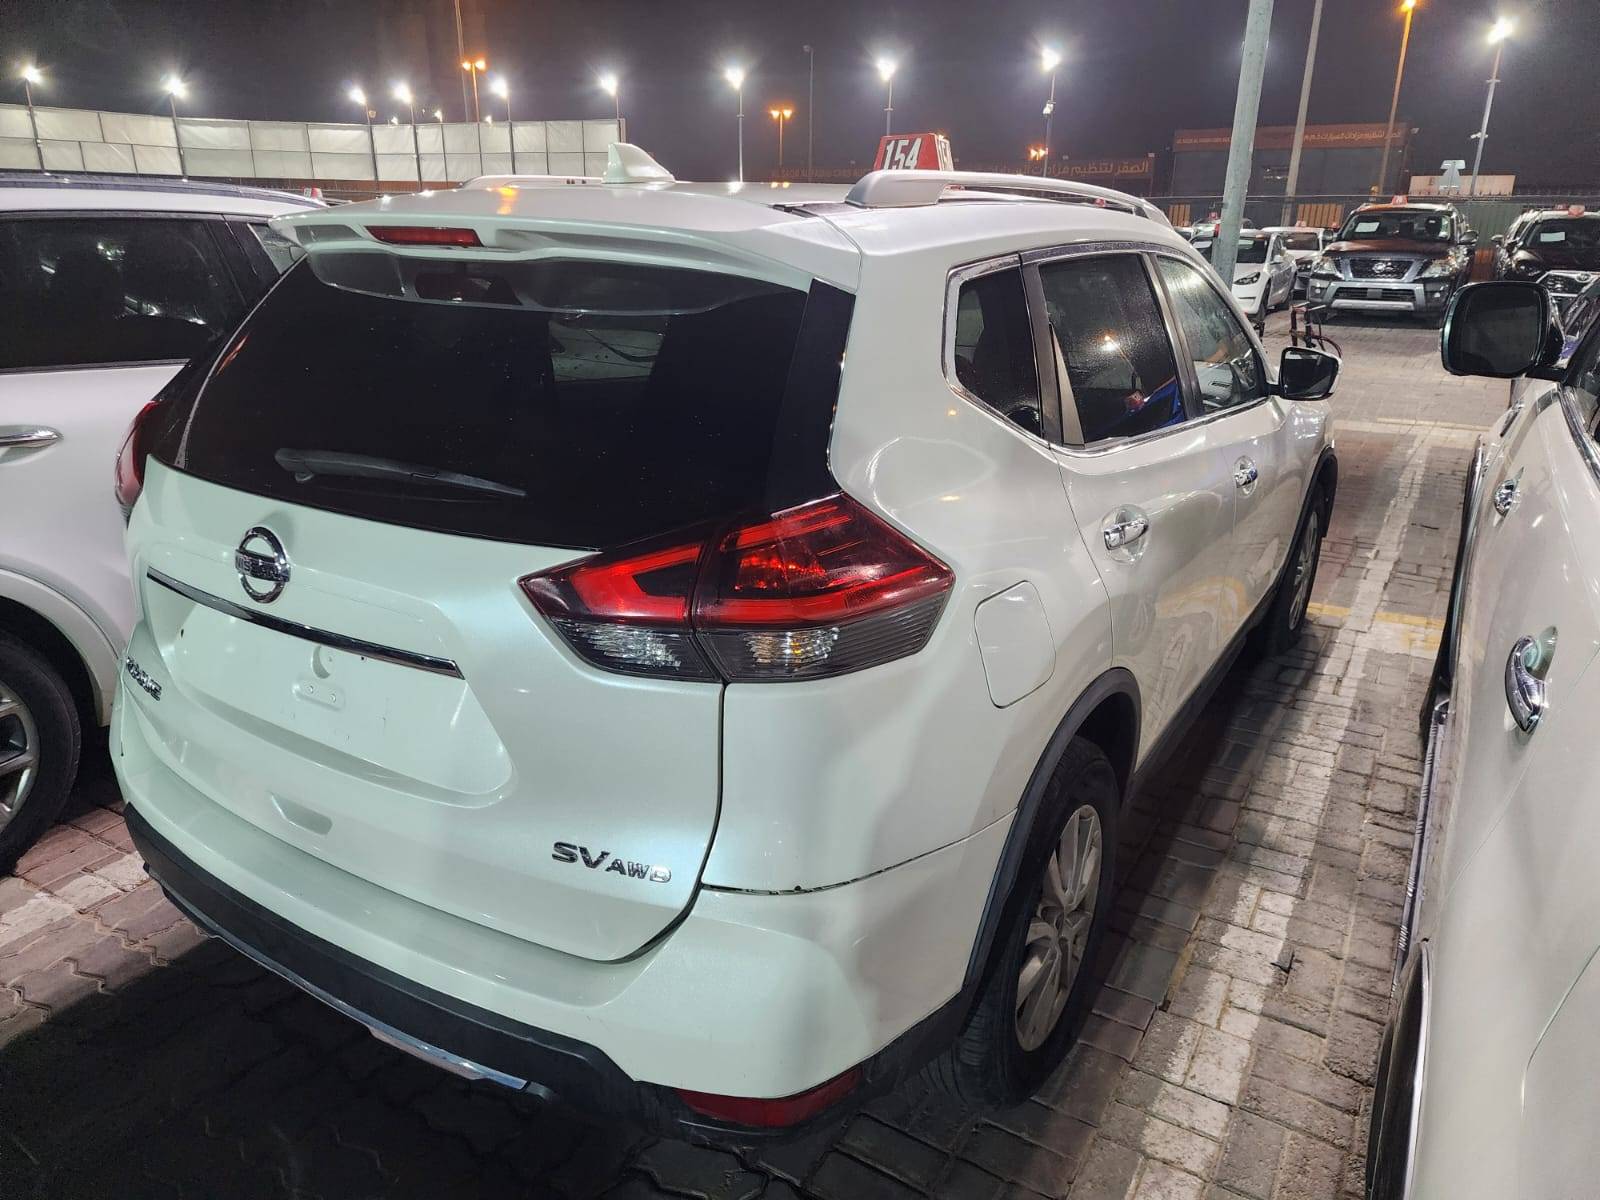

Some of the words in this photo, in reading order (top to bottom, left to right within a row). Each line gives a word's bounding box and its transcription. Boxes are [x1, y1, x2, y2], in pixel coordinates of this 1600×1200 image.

[884, 137, 921, 170] 154
[551, 841, 611, 869] SV
[605, 858, 672, 883] AWD
